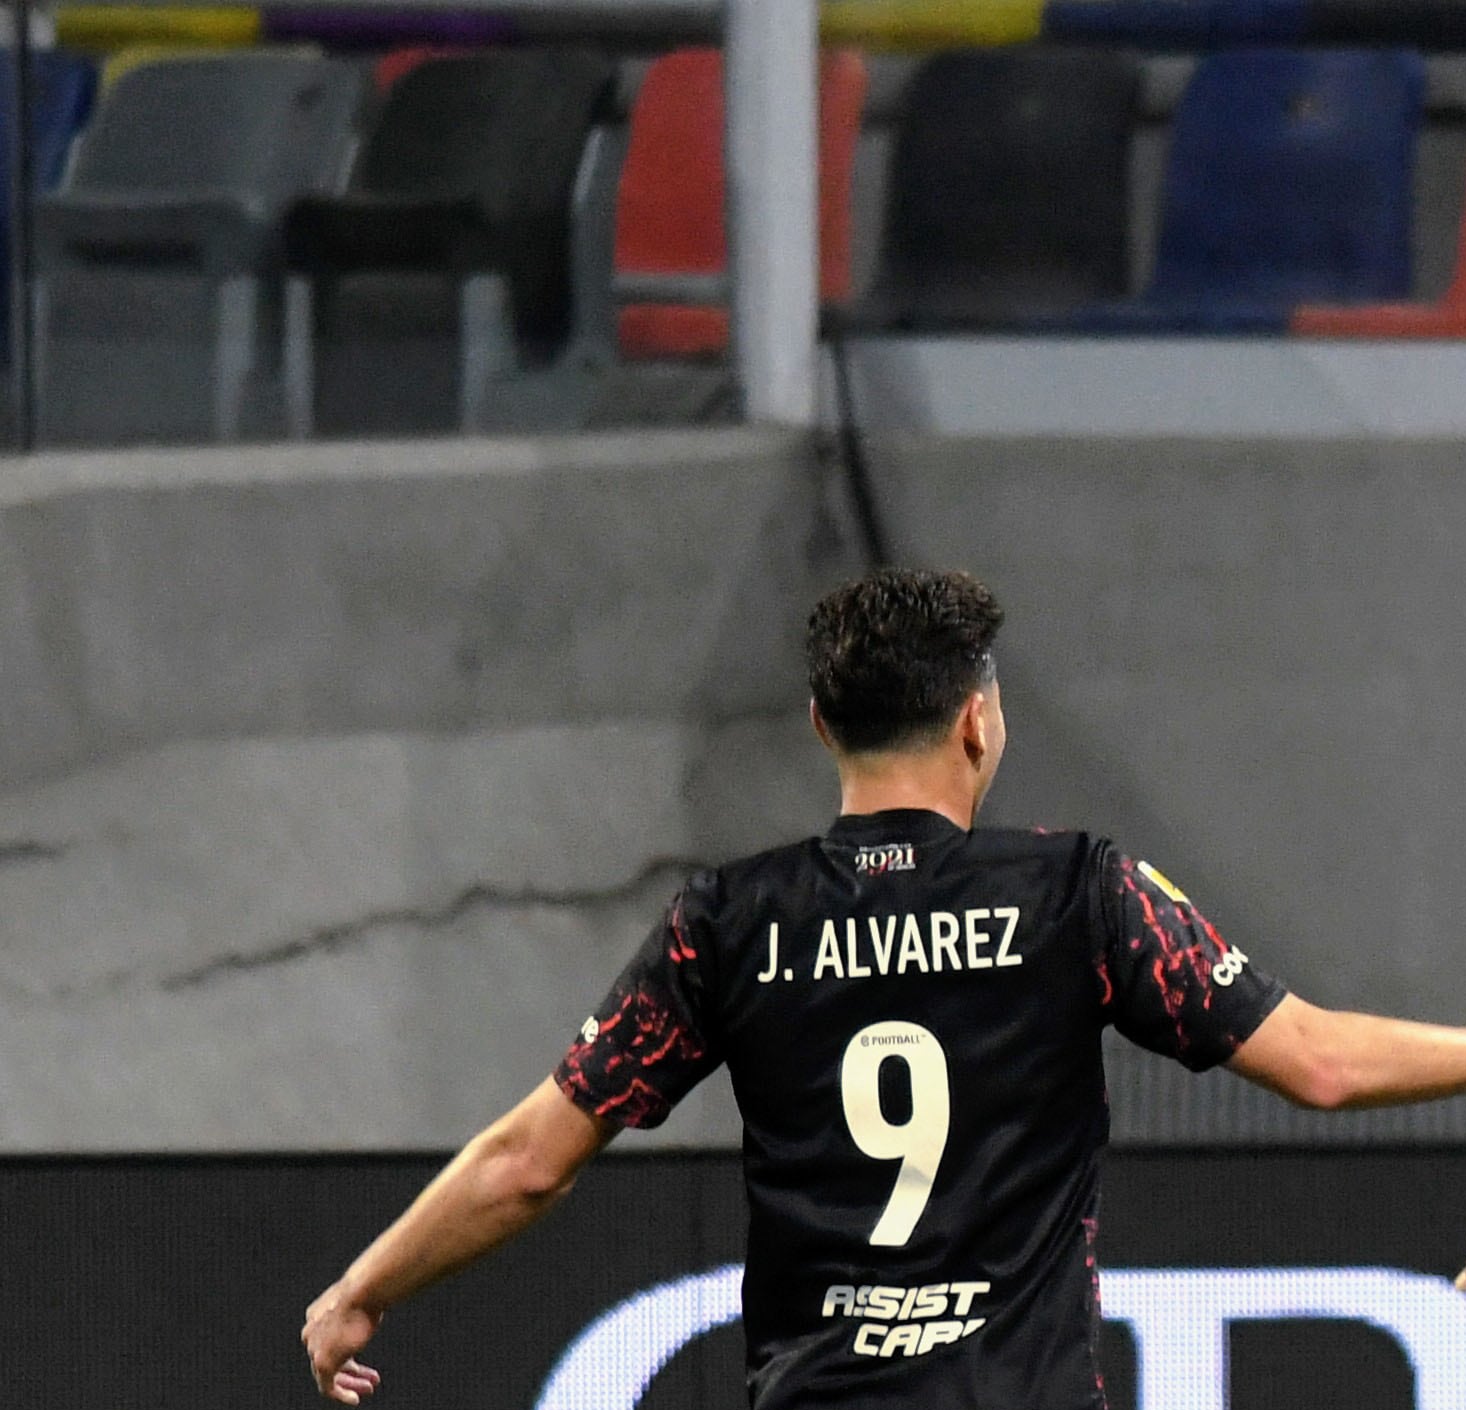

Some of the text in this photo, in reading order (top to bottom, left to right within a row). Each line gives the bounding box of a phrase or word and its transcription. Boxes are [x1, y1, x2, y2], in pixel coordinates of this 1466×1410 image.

[758, 906, 1023, 983] J. ALVAREZ
[841, 1020, 950, 1246] 9
